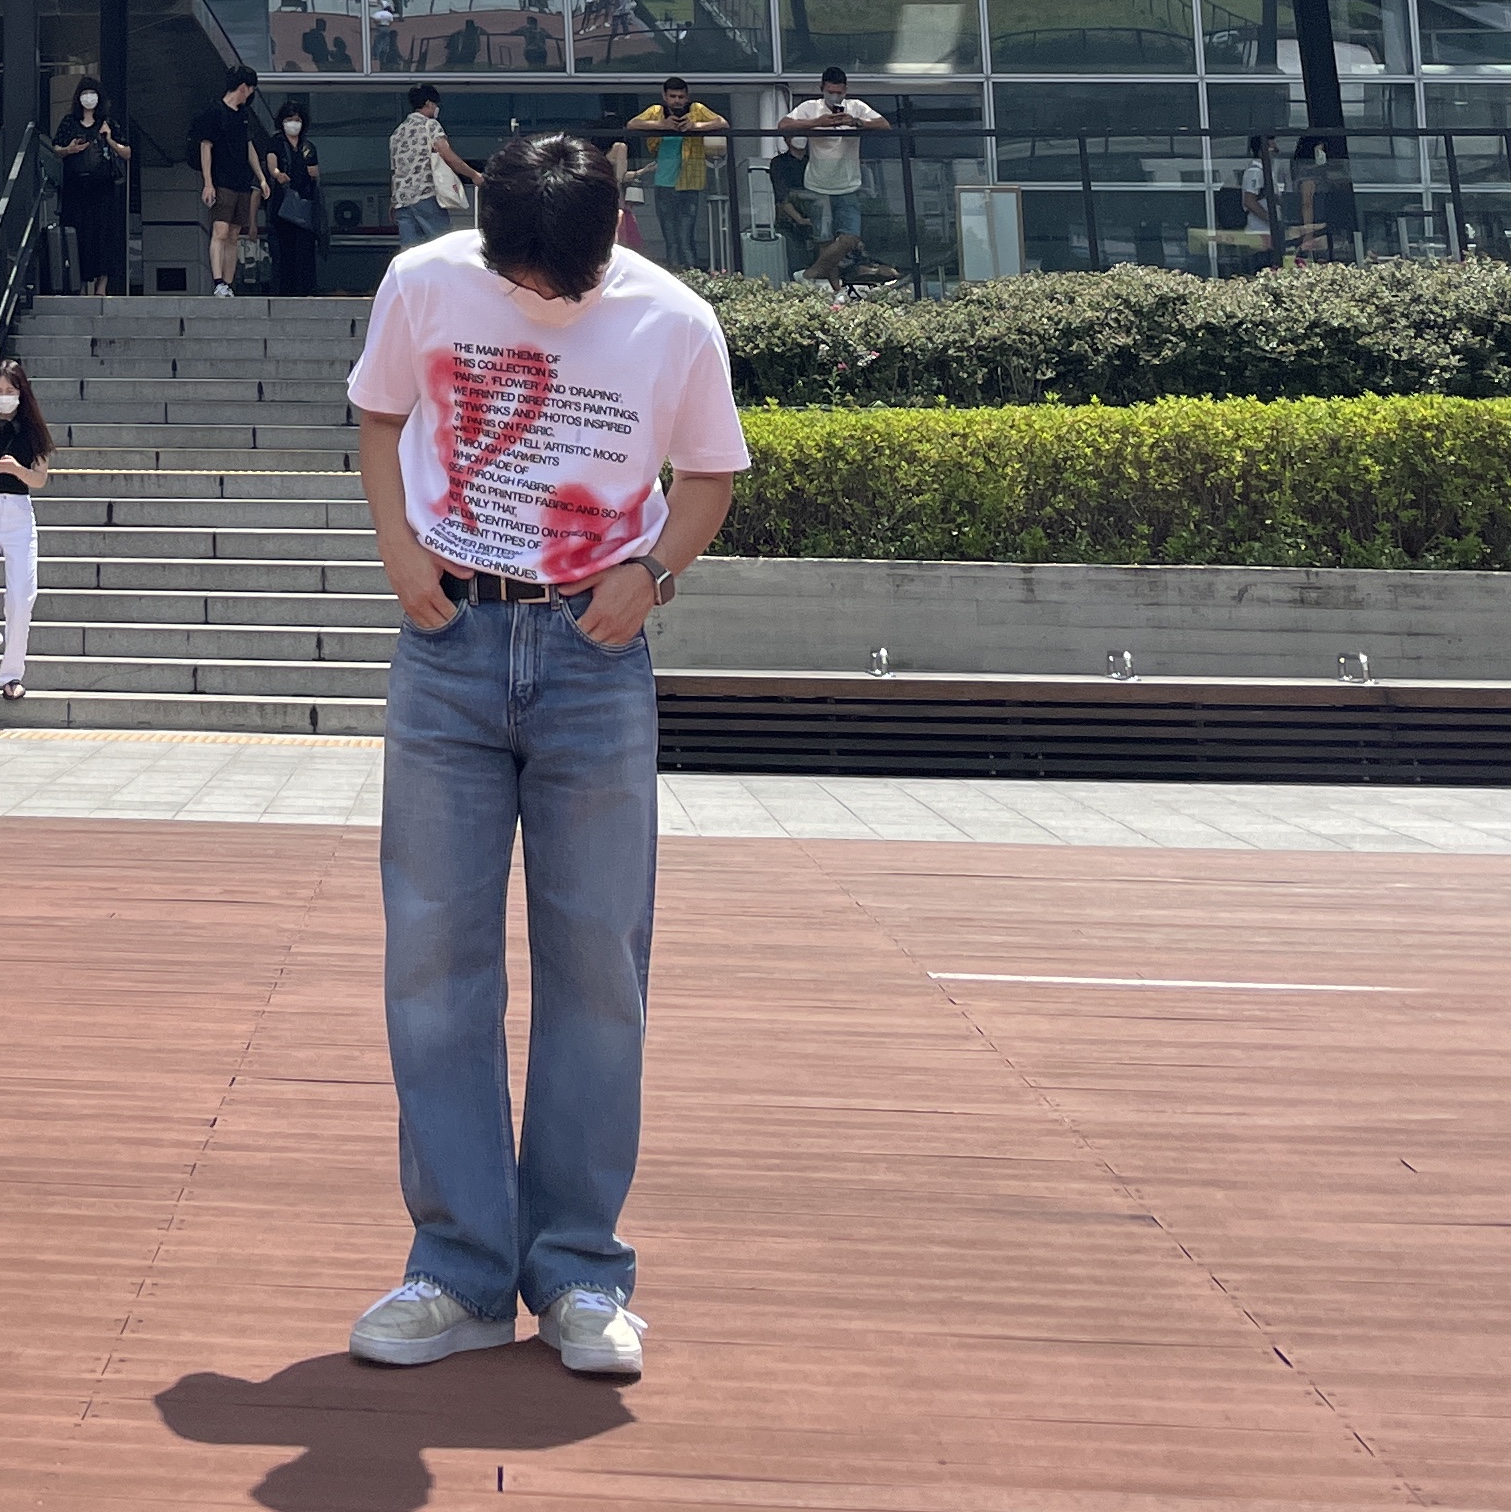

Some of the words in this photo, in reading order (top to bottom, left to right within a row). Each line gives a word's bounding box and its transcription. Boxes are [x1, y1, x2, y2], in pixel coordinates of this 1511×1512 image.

[453, 342, 474, 354] THE
[476, 345, 504, 357] MAIN
[506, 348, 544, 362] THEME
[545, 354, 561, 364] OF
[453, 357, 476, 369] THIS
[478, 360, 546, 377] COLLECTION
[548, 369, 558, 379] IS
[543, 383, 566, 395] AND
[453, 385, 468, 396] WE
[469, 387, 516, 402] PRINTED
[518, 394, 582, 412] DIRECTOR'S
[583, 402, 640, 424] PAINTINGS,
[466, 417, 497, 429] PARIS
[498, 420, 515, 432] ON
[516, 421, 555, 437] FABRIC.
[512, 408, 536, 420] AND
[538, 411, 582, 427] PHOTOS
[584, 418, 632, 435] INSPIRED
[454, 435, 502, 455] THROUGH
[503, 448, 560, 467] GARMENTS
[472, 427, 501, 440] TRIED
[502, 433, 516, 445] TO
[518, 438, 541, 450] TELL
[593, 448, 628, 463] MOOD'
[453, 449, 484, 465] WHICH
[484, 459, 512, 472] MADE
[514, 463, 529, 474] OF
[448, 462, 464, 473] SEE
[466, 466, 515, 487] THROUGH
[516, 478, 558, 496] FABRIC,
[463, 494, 490, 511] ONLY
[491, 500, 518, 517] THAT,
[488, 486, 534, 505] PRINTED
[575, 502, 600, 516] AND
[601, 508, 617, 519] SO
[436, 522, 477, 549] FLOWER
[442, 517, 491, 538] DIFFERENT
[492, 531, 526, 547] TYPES
[527, 538, 543, 549] OF
[461, 508, 539, 535] CONCENTRATED
[541, 526, 558, 538] ON
[425, 536, 467, 561] DRAPING
[470, 554, 538, 580] TECHNIQUES
